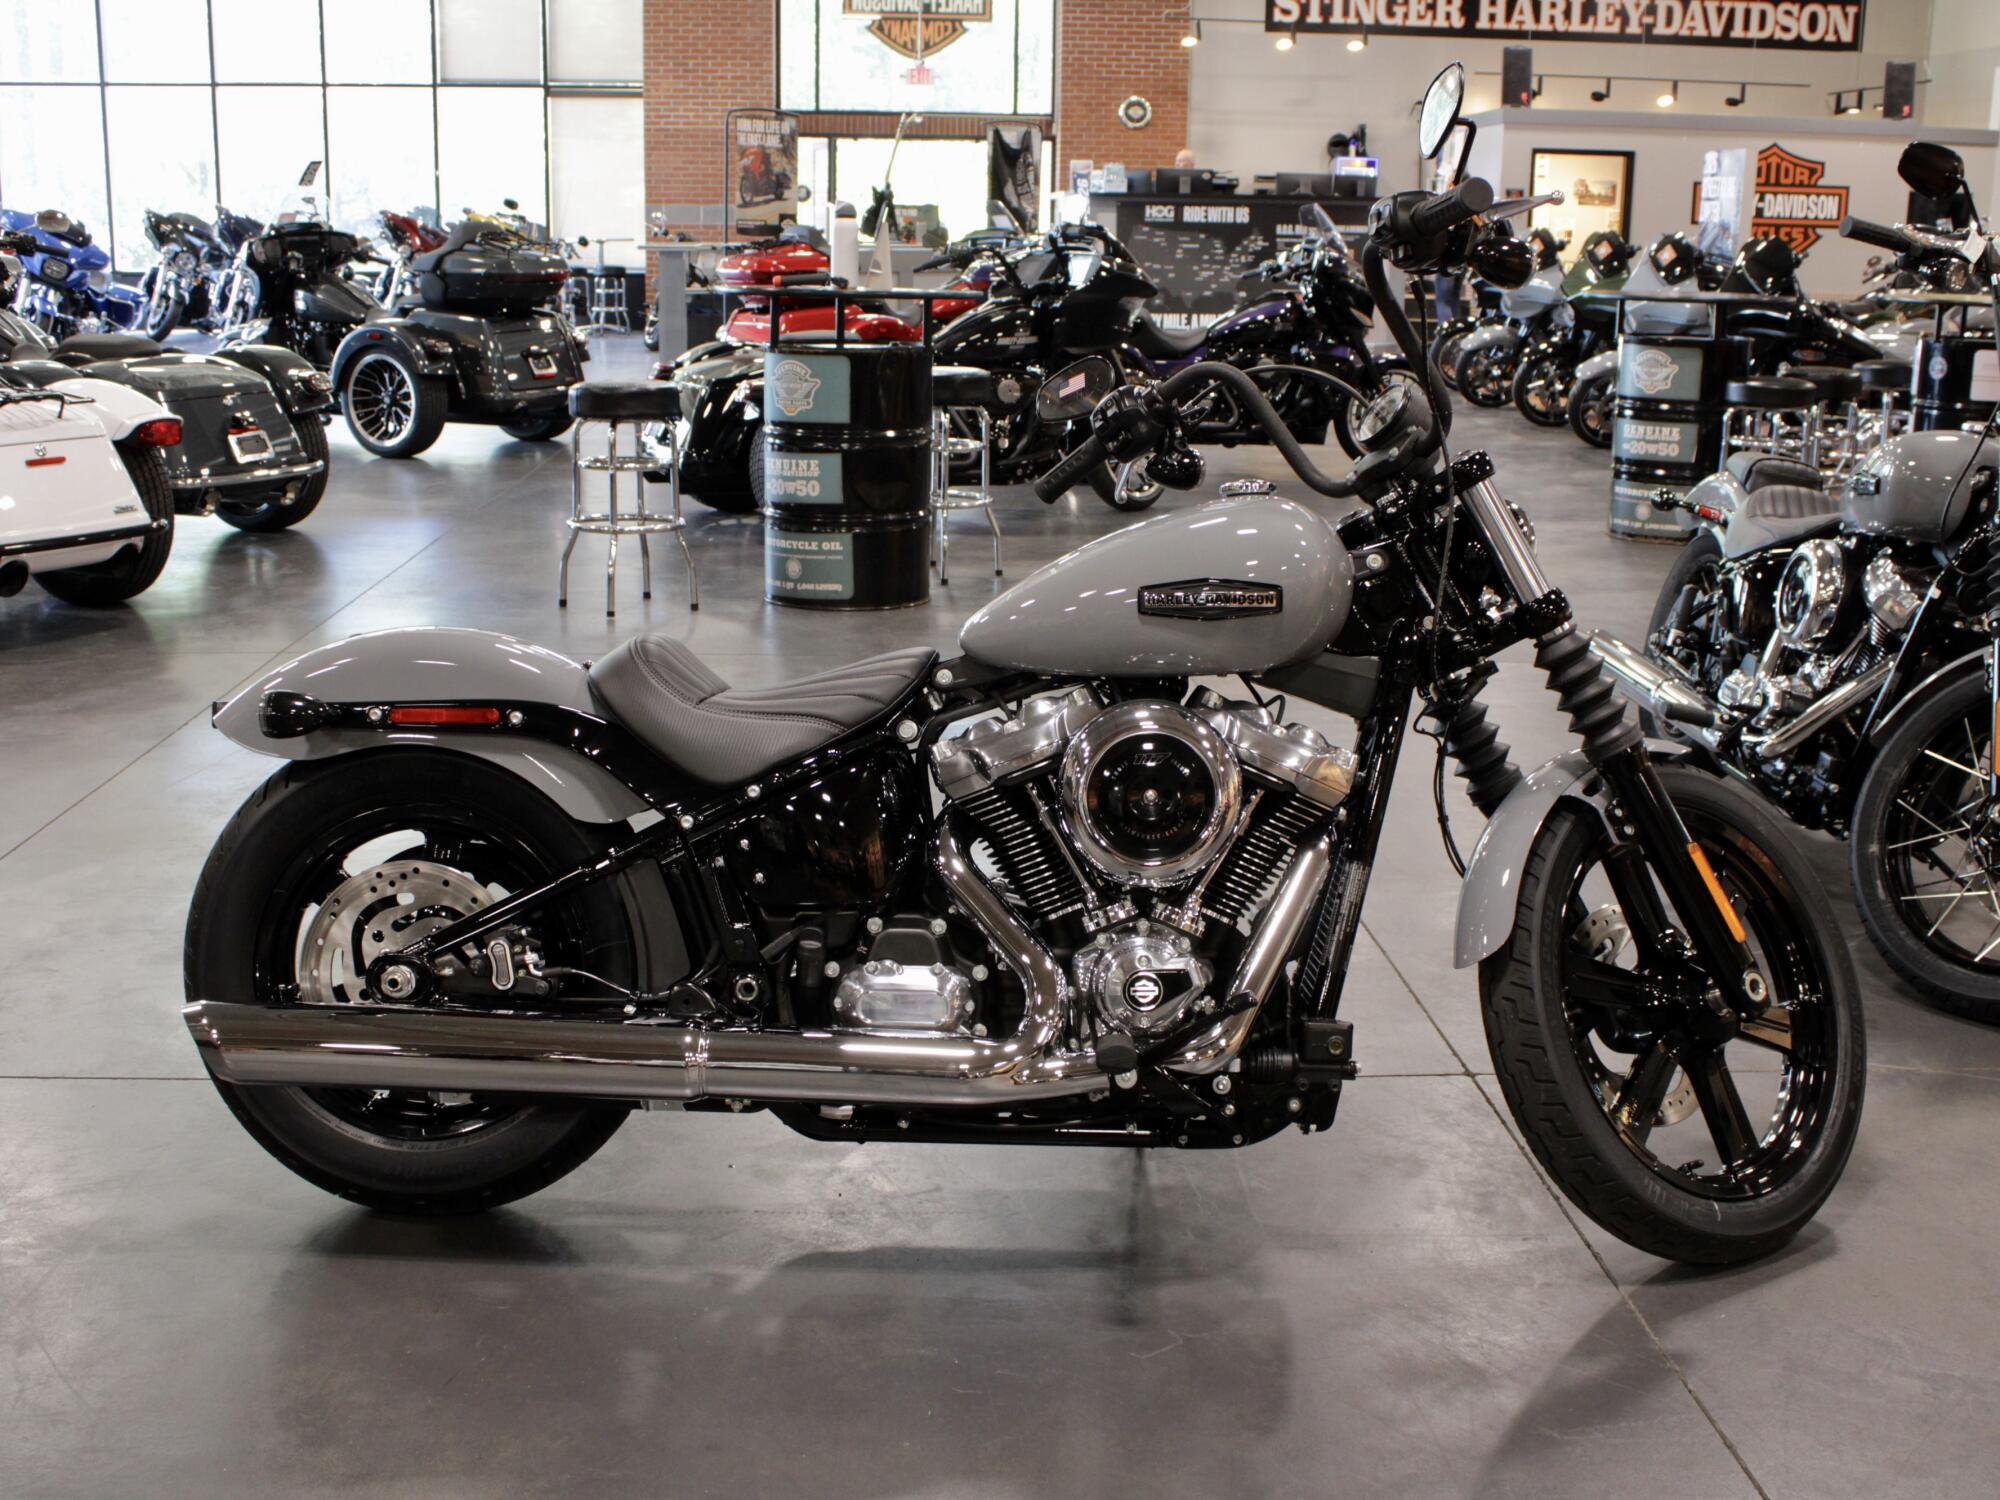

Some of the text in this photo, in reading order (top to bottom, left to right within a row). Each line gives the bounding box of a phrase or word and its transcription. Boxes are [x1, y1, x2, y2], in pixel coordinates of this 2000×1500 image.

[1273, 0, 1857, 43] STINGER HARLEY-DAVIDSON
[1757, 154, 1810, 185] OTOR
[1183, 206, 1207, 223] RIDE
[1208, 206, 1234, 223] WITH
[1236, 206, 1250, 224] US
[822, 541, 843, 550] OIL
[1145, 592, 1277, 607] HARLEY-DAVIDSON
